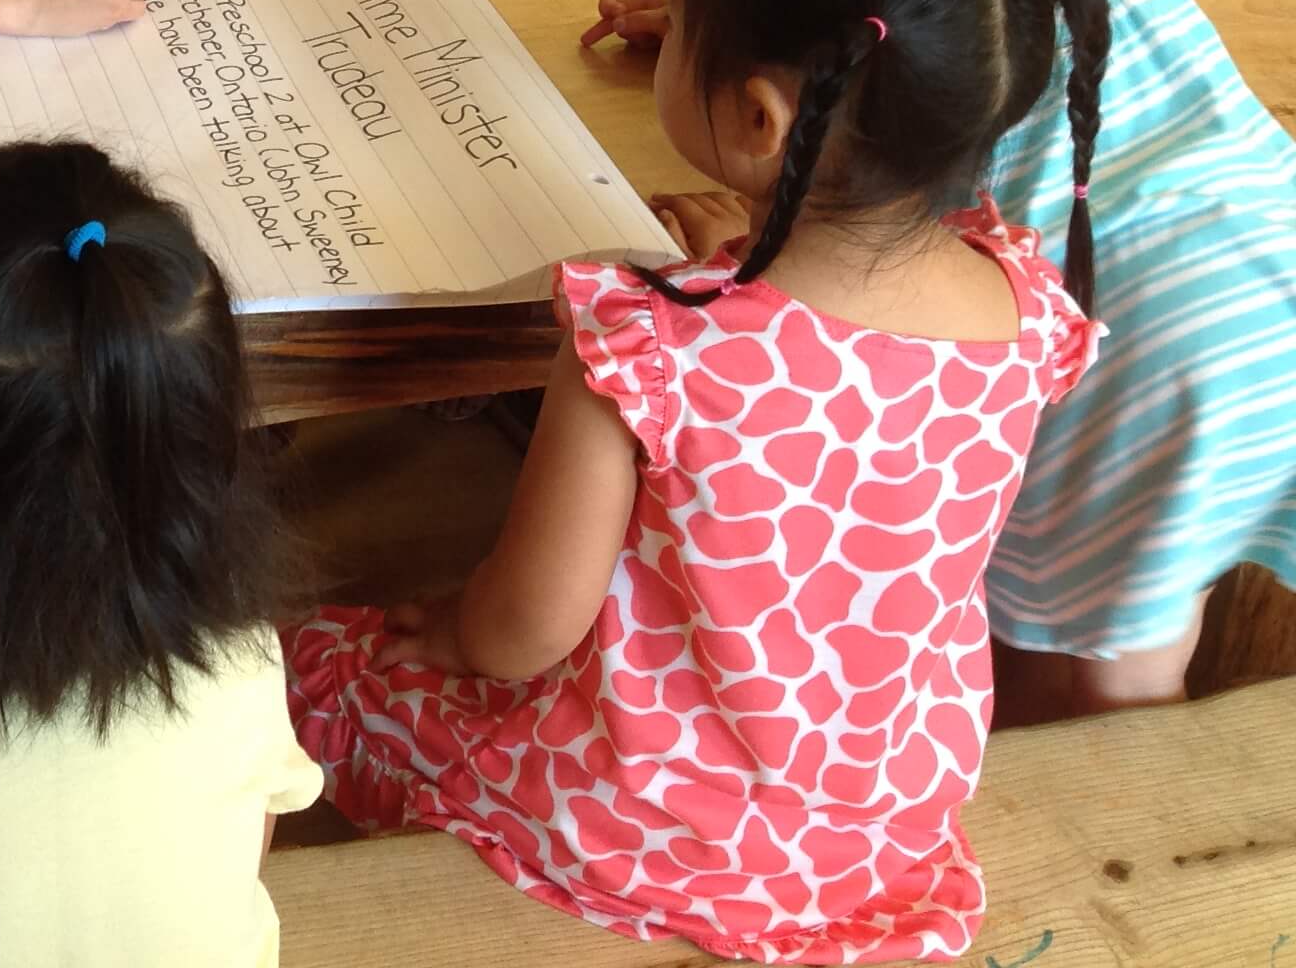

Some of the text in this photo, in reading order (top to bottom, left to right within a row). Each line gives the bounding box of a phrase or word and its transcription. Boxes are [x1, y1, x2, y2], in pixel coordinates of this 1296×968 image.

[263, 92, 294, 106] 2
[302, 11, 402, 142] Trudeau
[403, 39, 518, 169] Minister
[159, 17, 190, 57] have
[178, 63, 213, 111] been
[201, 116, 255, 188] talking
[242, 195, 302, 252] about
[275, 114, 311, 134] at
[294, 142, 343, 182] Owl
[215, 65, 268, 143] Ontario
[257, 147, 302, 203] (John
[293, 208, 359, 285] Sweeney
[324, 189, 384, 247] Child
